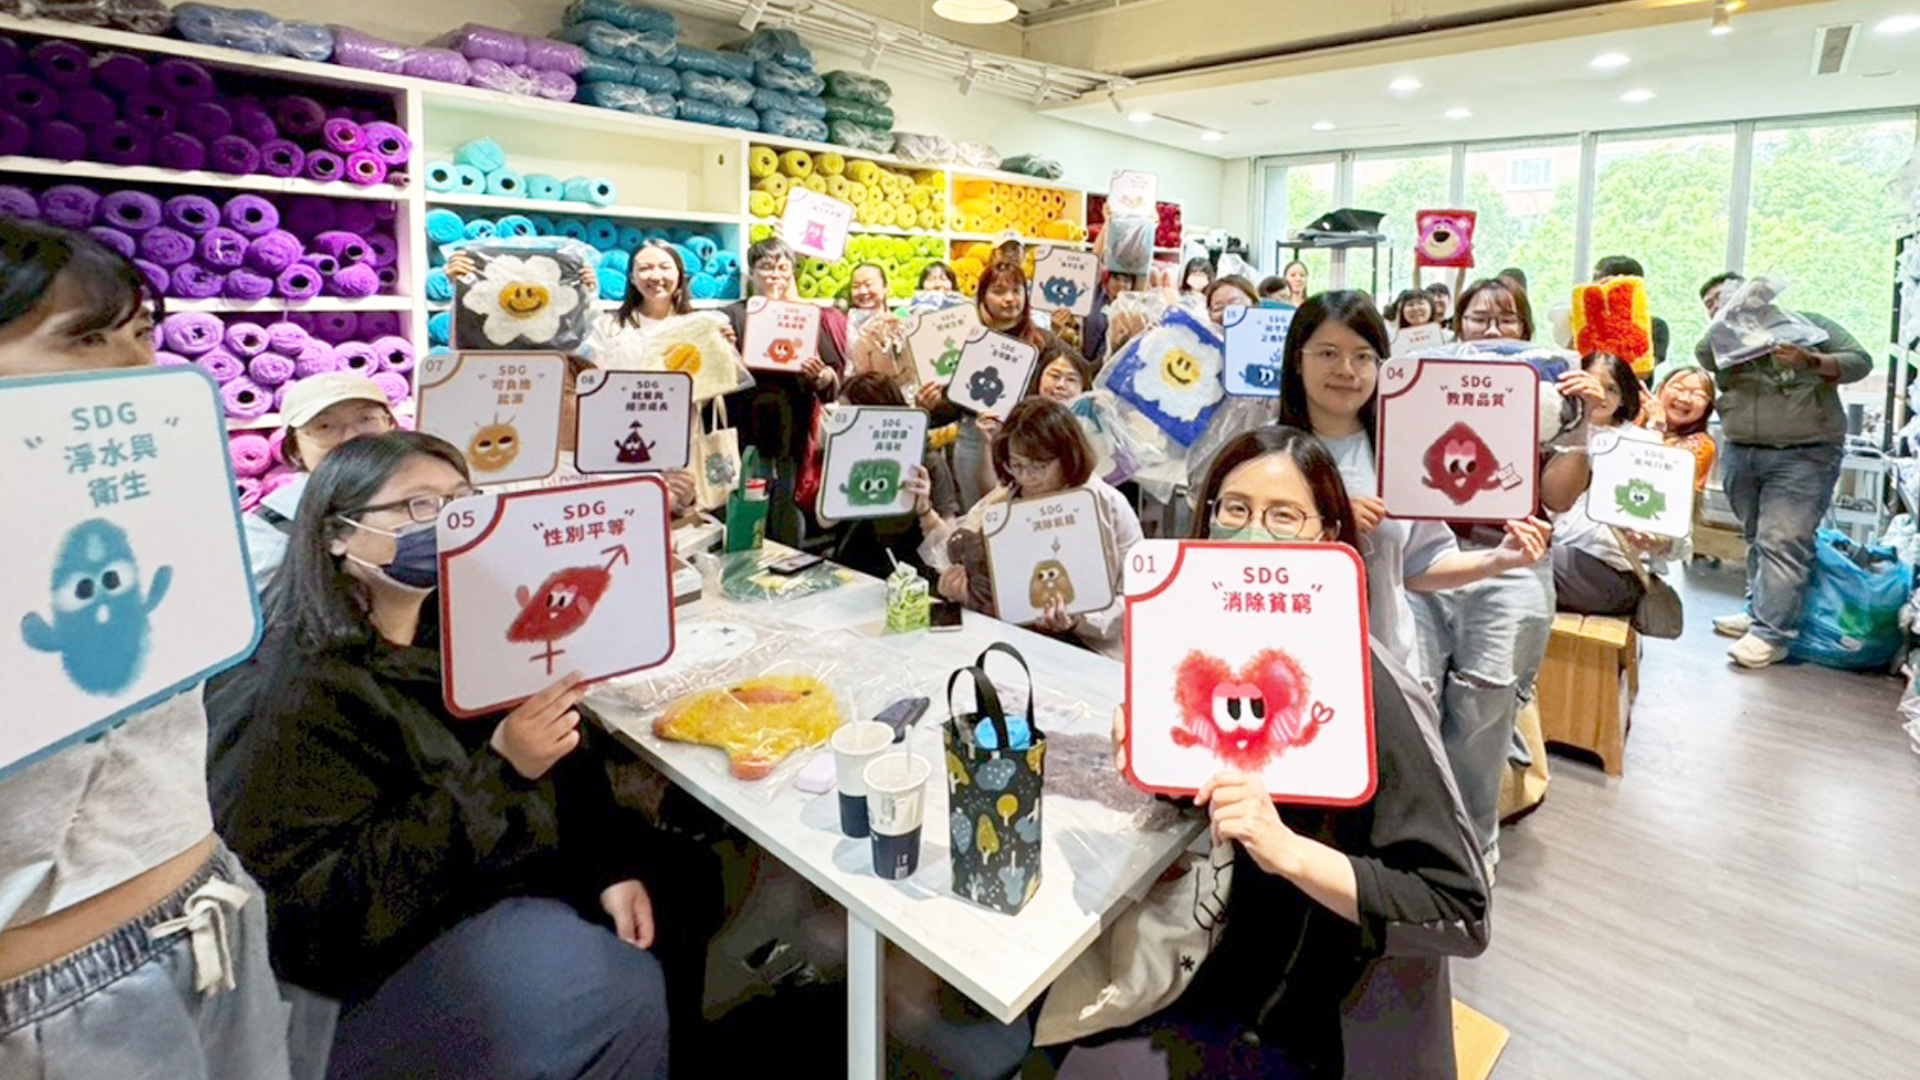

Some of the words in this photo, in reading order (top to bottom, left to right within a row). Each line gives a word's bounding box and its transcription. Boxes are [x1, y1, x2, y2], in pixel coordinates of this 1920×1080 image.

[1268, 315, 1287, 323] SDG
[425, 359, 444, 373] 07
[498, 365, 527, 376] SDG
[1386, 366, 1404, 380] 04
[581, 375, 595, 385] 08
[636, 380, 659, 389] SDG
[1460, 375, 1493, 388] SDG
[1446, 391, 1506, 407] 教育品質
[71, 401, 138, 432] SDG
[835, 413, 847, 423] 03
[882, 418, 902, 428] SDG
[63, 433, 158, 474] 淨水與
[87, 470, 151, 508] 衛生
[562, 500, 606, 520] SDG
[1039, 503, 1063, 516] SDG
[446, 510, 476, 530] 05
[985, 512, 999, 523] 02
[543, 518, 626, 547] 性別平等
[1132, 554, 1156, 573] 01
[1243, 566, 1289, 584] SDG
[1222, 591, 1313, 614] 消除貧窮
